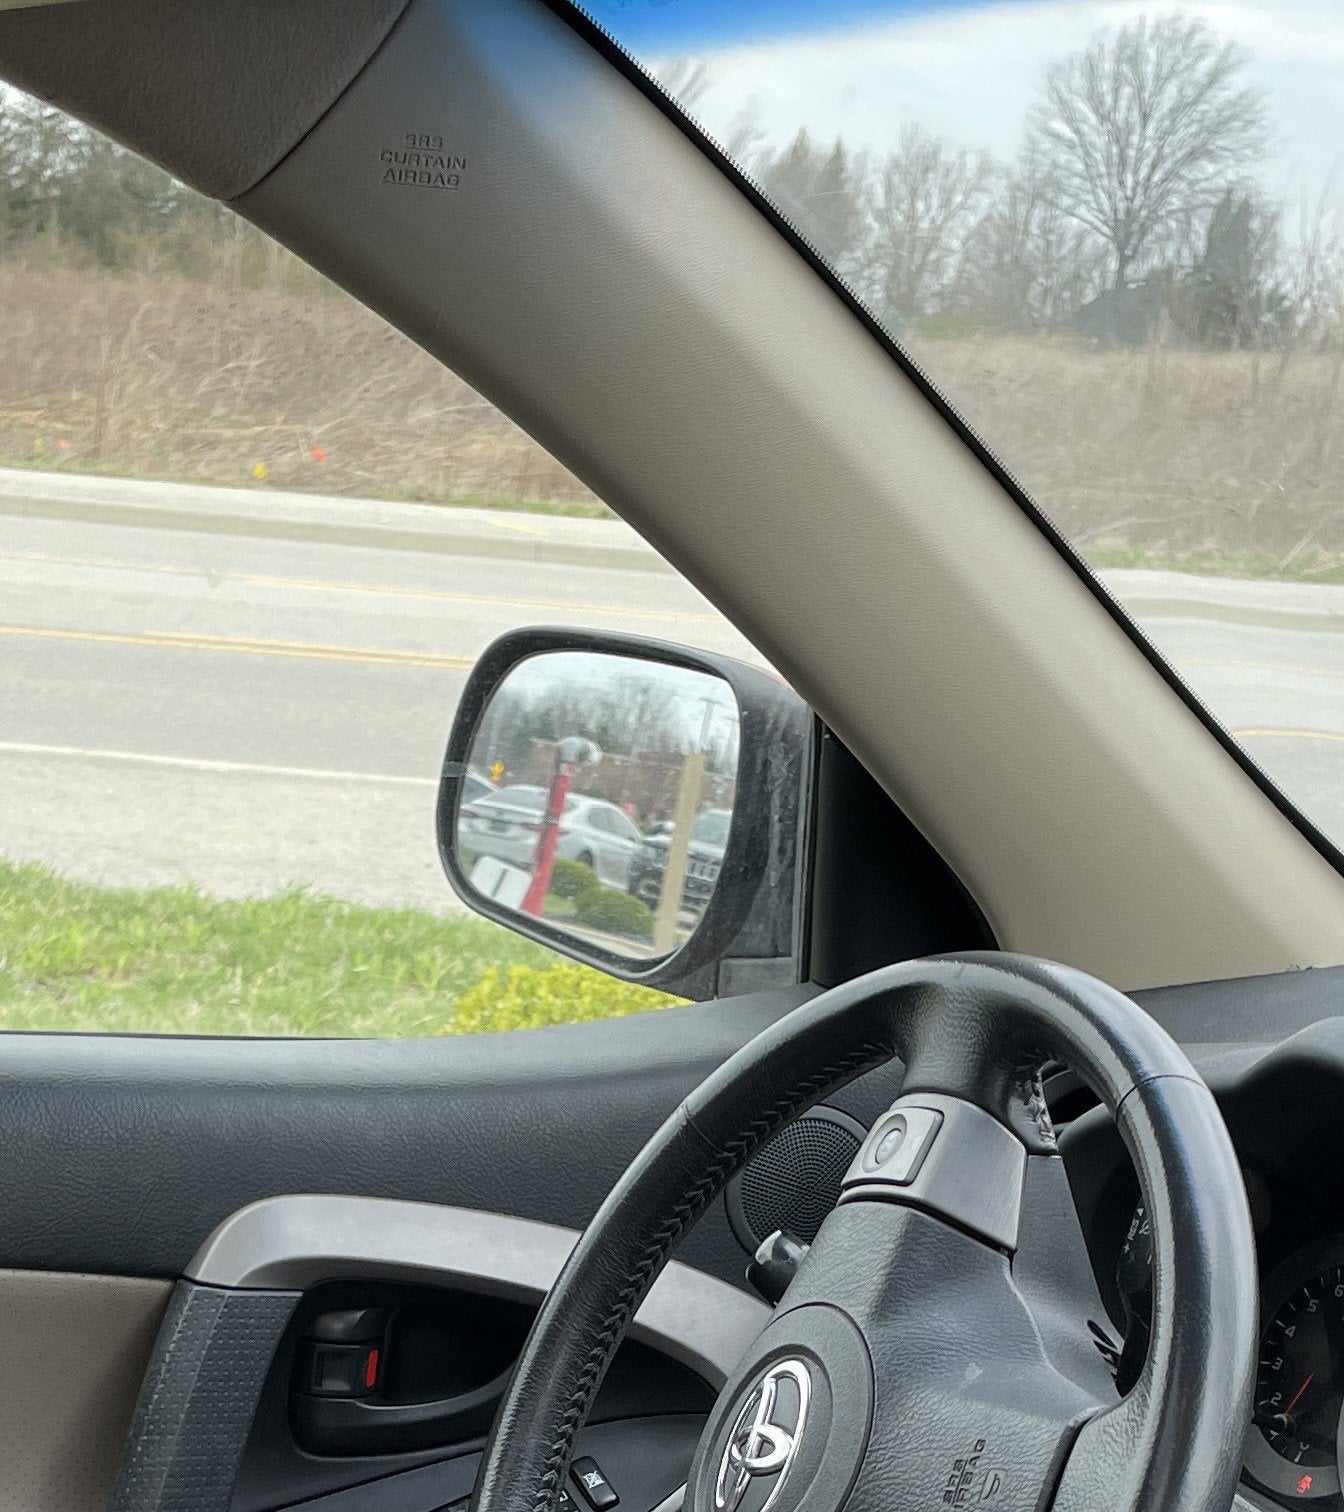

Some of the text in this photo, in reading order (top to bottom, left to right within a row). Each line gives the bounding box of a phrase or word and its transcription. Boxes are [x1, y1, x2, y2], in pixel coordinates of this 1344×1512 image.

[380, 149, 467, 170] CURTAIN
[383, 167, 461, 188] AIRBAG
[1307, 1299, 1319, 1313] 5
[1285, 1325, 1297, 1338] 4
[1272, 1357, 1284, 1371] 3
[1271, 1392, 1283, 1406] 2
